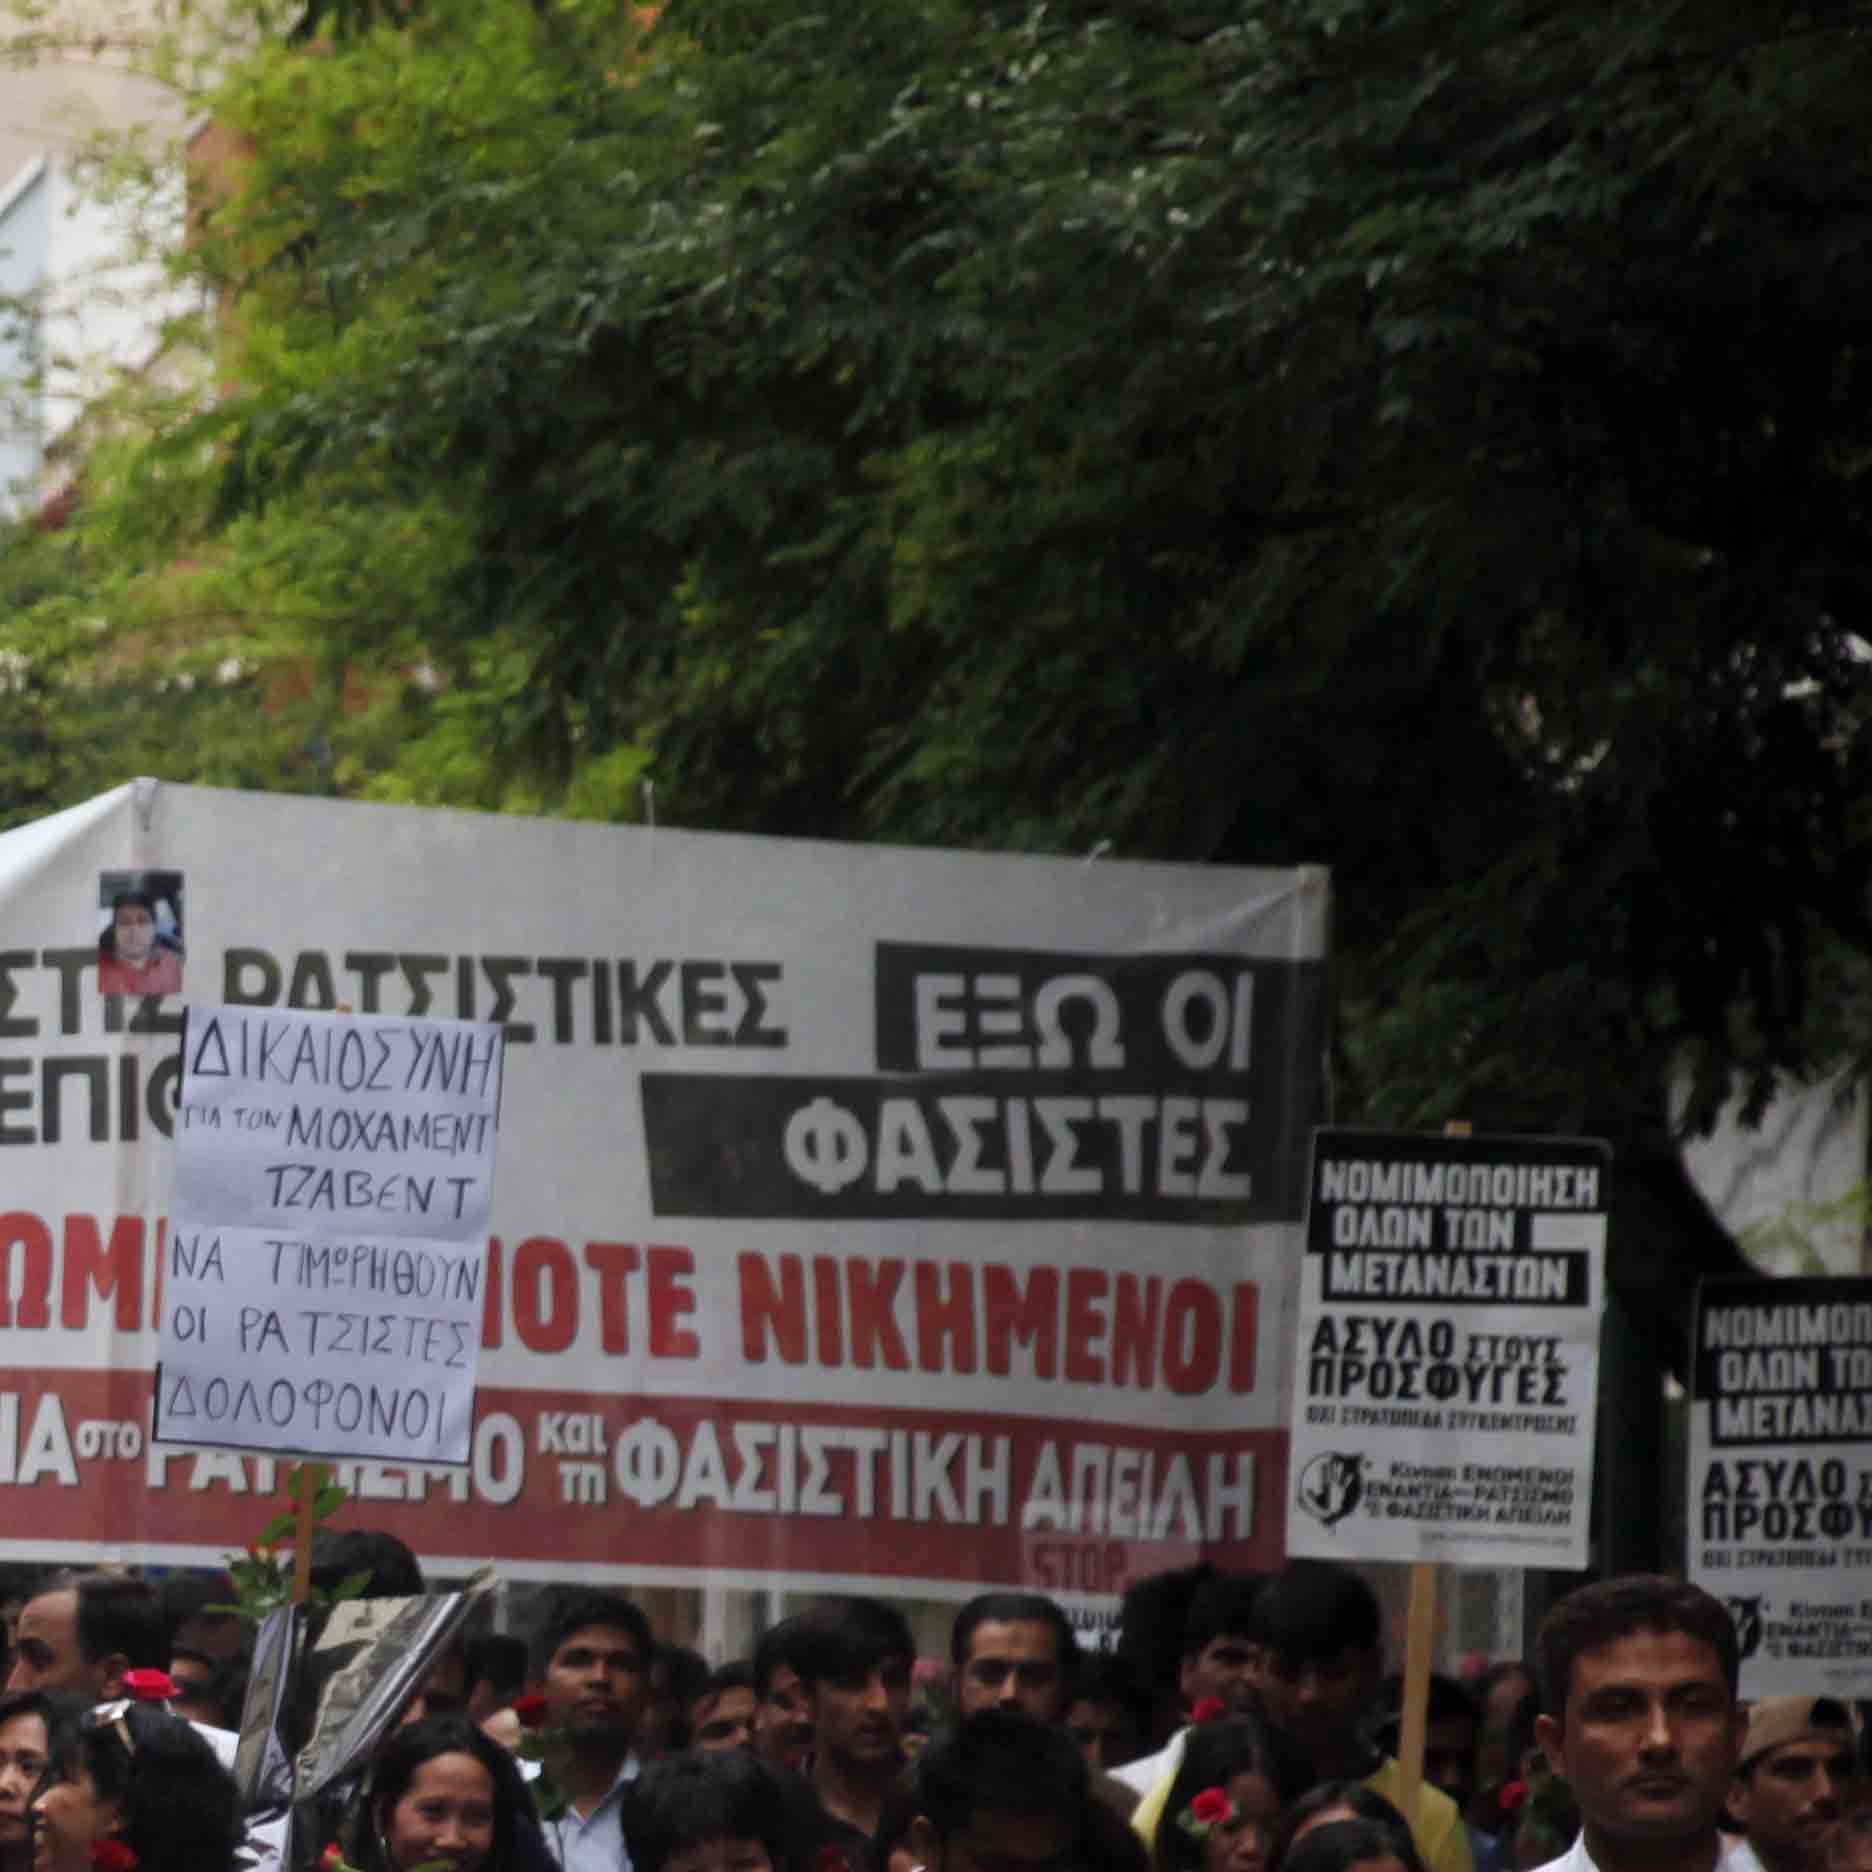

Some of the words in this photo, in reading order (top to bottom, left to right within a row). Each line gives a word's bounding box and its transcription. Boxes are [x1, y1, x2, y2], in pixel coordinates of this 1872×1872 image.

[915, 970, 1124, 1071] ΕΞΩ
[1165, 968, 1253, 1073] ΟΙ
[191, 1016, 496, 1098] ΔΙΚΑΙΟΣΥΝΗ
[184, 1103, 222, 1130] ΓΙΑ
[234, 1106, 283, 1130] ΤΟΝ
[285, 1104, 492, 1156] ΜΟΧΑΜΕΝΤ
[784, 1094, 1252, 1200] ΦΑΣΙΣΤΕΣ
[264, 1164, 477, 1220] ΤΖΑΒΕΝΤ
[1321, 1160, 1600, 1208] ΝΟΜΙΜΟΠΟΙΗΣΗ
[1333, 1205, 1432, 1249] ΟΛΩΝ
[1444, 1208, 1516, 1251] ΤΩΝ
[172, 1235, 225, 1282] ΝΑ
[264, 1241, 481, 1302] ΤΙΜΩΡΗΘΟΥΝ
[1330, 1252, 1569, 1299] ΜΕΤΑΝΑΣΤΩΝ
[172, 1305, 207, 1344] ΟΙ
[240, 1307, 470, 1369] ΡΑΤΣΙΣΤΕΣ
[483, 1236, 700, 1363] ΟΤΕ
[738, 1251, 1259, 1397] ΝΙΚΗΜΕΝΟΙ
[1312, 1315, 1454, 1360] ΑΣΥΛΟ
[1467, 1334, 1562, 1364] ΣΤΟΥΣ
[1309, 1357, 1570, 1406] ΠΡΟΣΦΥΓΕΣ
[1719, 1348, 1820, 1392] ΟΛΩΝ
[167, 1376, 447, 1445] ΔΟΛΟΦΟΝΟΙ
[537, 1412, 607, 1455] και
[76, 1416, 142, 1462] στο
[559, 1463, 607, 1505] τη
[616, 1415, 1010, 1531] ΦΑΣΙΣΤΙΚΗ
[1025, 1443, 1253, 1544] ΑΠΕΙΛΗ
[1702, 1458, 1847, 1501] ΑΣΥΛΟ
